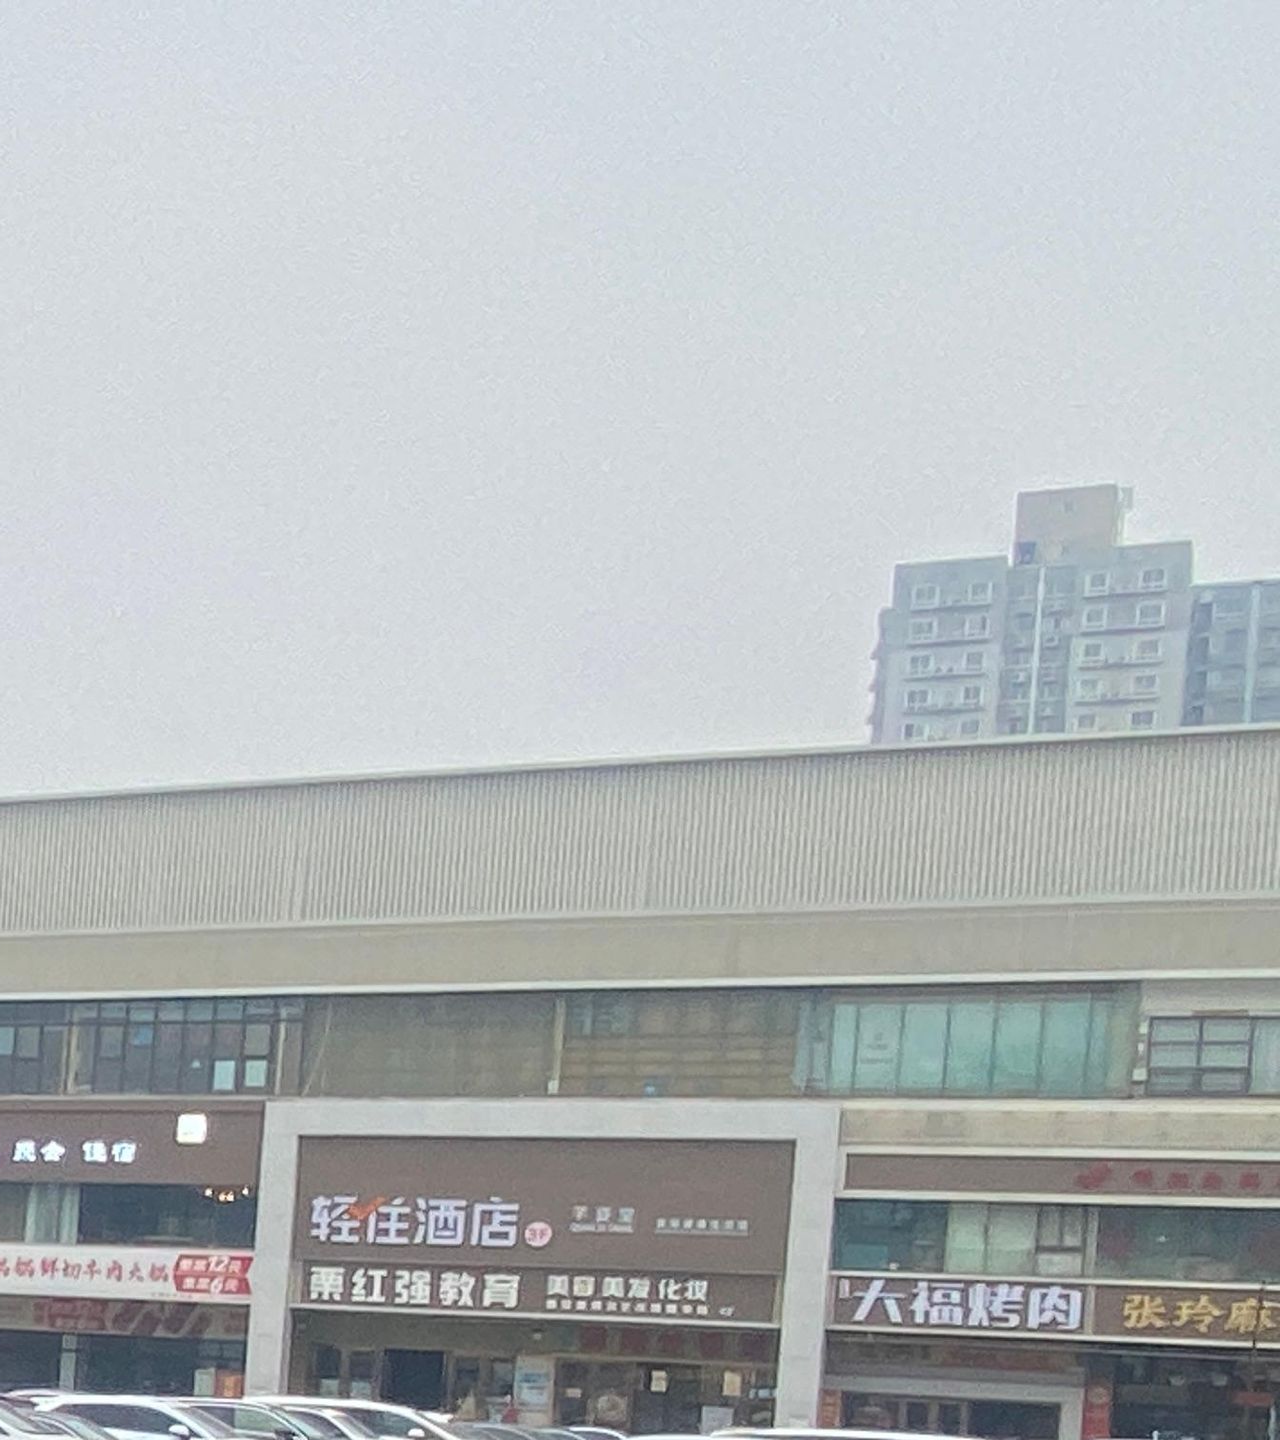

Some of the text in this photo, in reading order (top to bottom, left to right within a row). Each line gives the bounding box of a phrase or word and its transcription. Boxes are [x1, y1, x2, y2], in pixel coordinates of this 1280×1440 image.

[310, 1195, 520, 1247] 轻住酒店
[852, 1279, 1083, 1331] 大福烤肉
